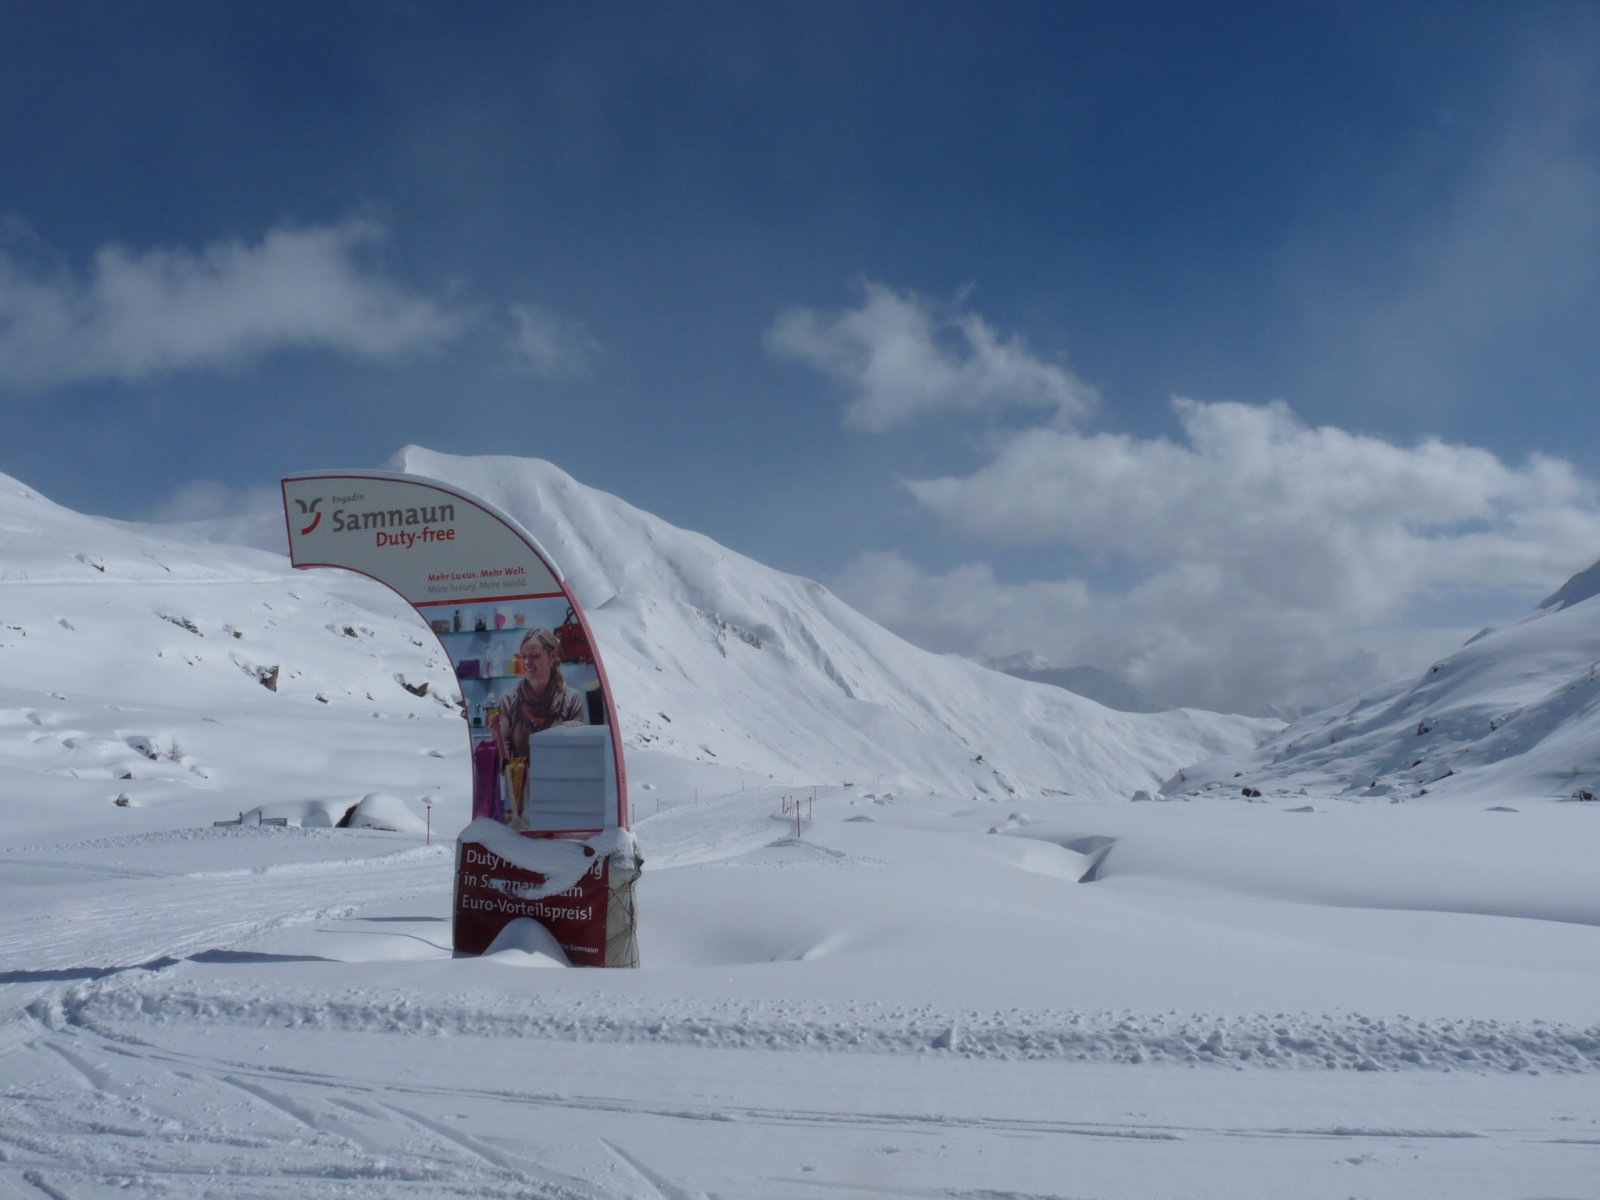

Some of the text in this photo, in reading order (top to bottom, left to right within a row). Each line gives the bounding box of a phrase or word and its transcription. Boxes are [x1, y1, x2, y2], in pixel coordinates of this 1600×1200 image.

[332, 493, 365, 505] Engadin
[332, 503, 455, 533] Samnaun
[376, 526, 455, 549] Duty-free
[427, 566, 527, 582] Mehr Luxus. Mehr Welt.
[428, 579, 527, 593] More luxury. More world.
[466, 849, 500, 871] Duty
[464, 872, 477, 887] in
[462, 895, 593, 922] Euro-Vorteilspreis!
